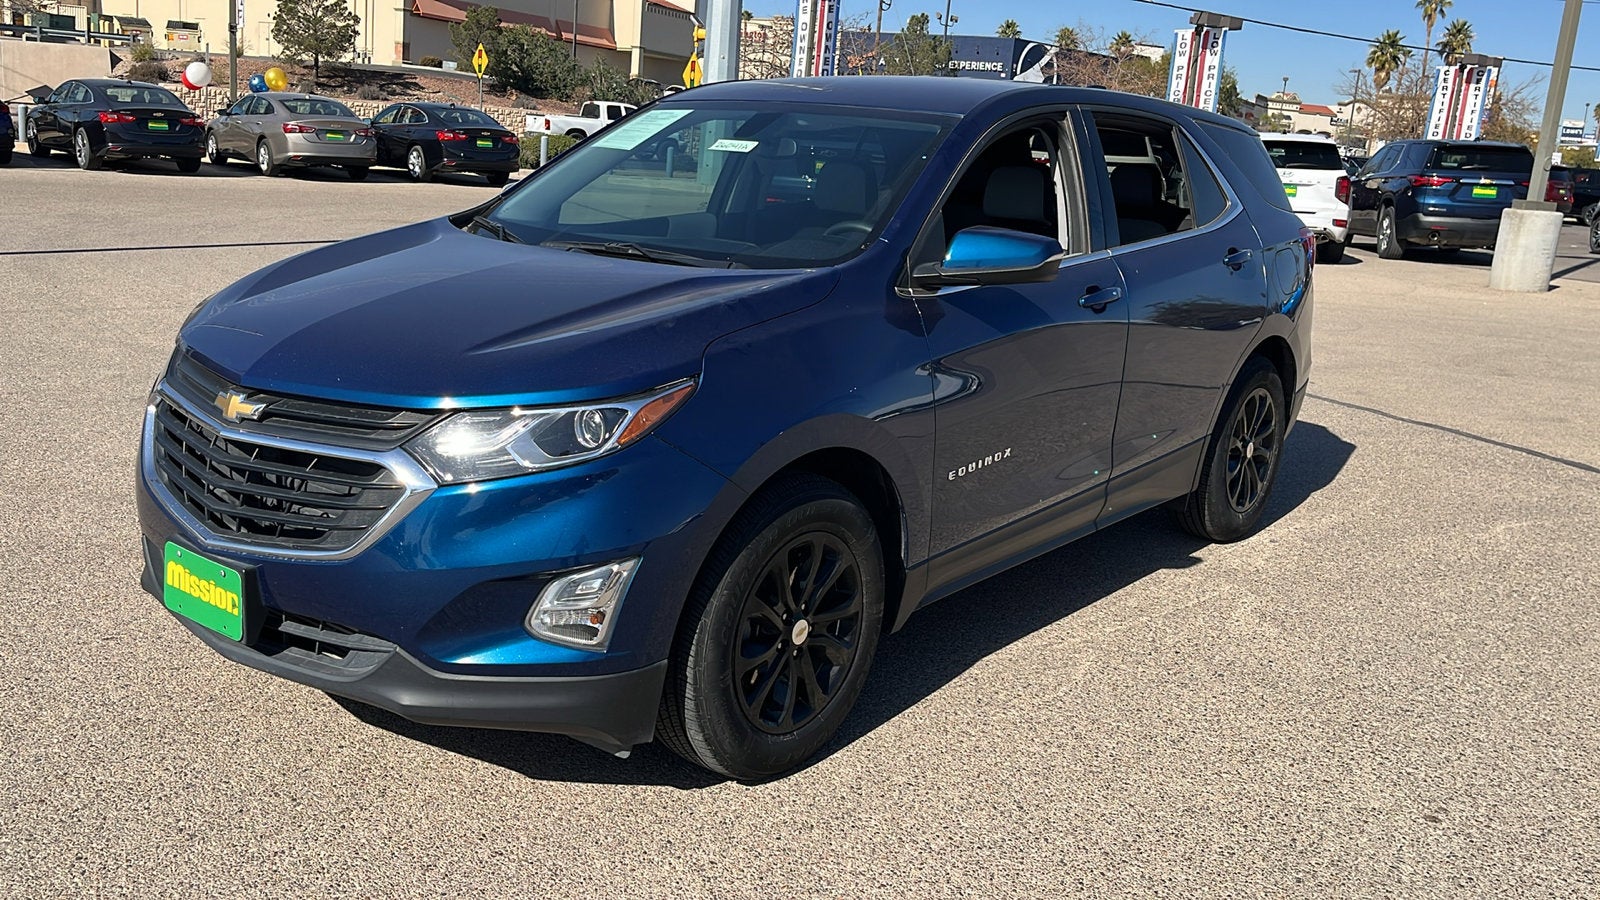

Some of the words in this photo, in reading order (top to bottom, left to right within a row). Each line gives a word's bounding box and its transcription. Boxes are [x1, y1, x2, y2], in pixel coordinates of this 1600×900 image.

[1178, 34, 1187, 57] LOW
[1210, 33, 1220, 57] LOW
[949, 60, 1003, 72] EXPERIENCE
[1432, 69, 1450, 137] CERTIFIED
[1465, 69, 1485, 139] CERTIFIED
[948, 447, 1011, 481] EQUINOX
[166, 560, 239, 617] Mission
